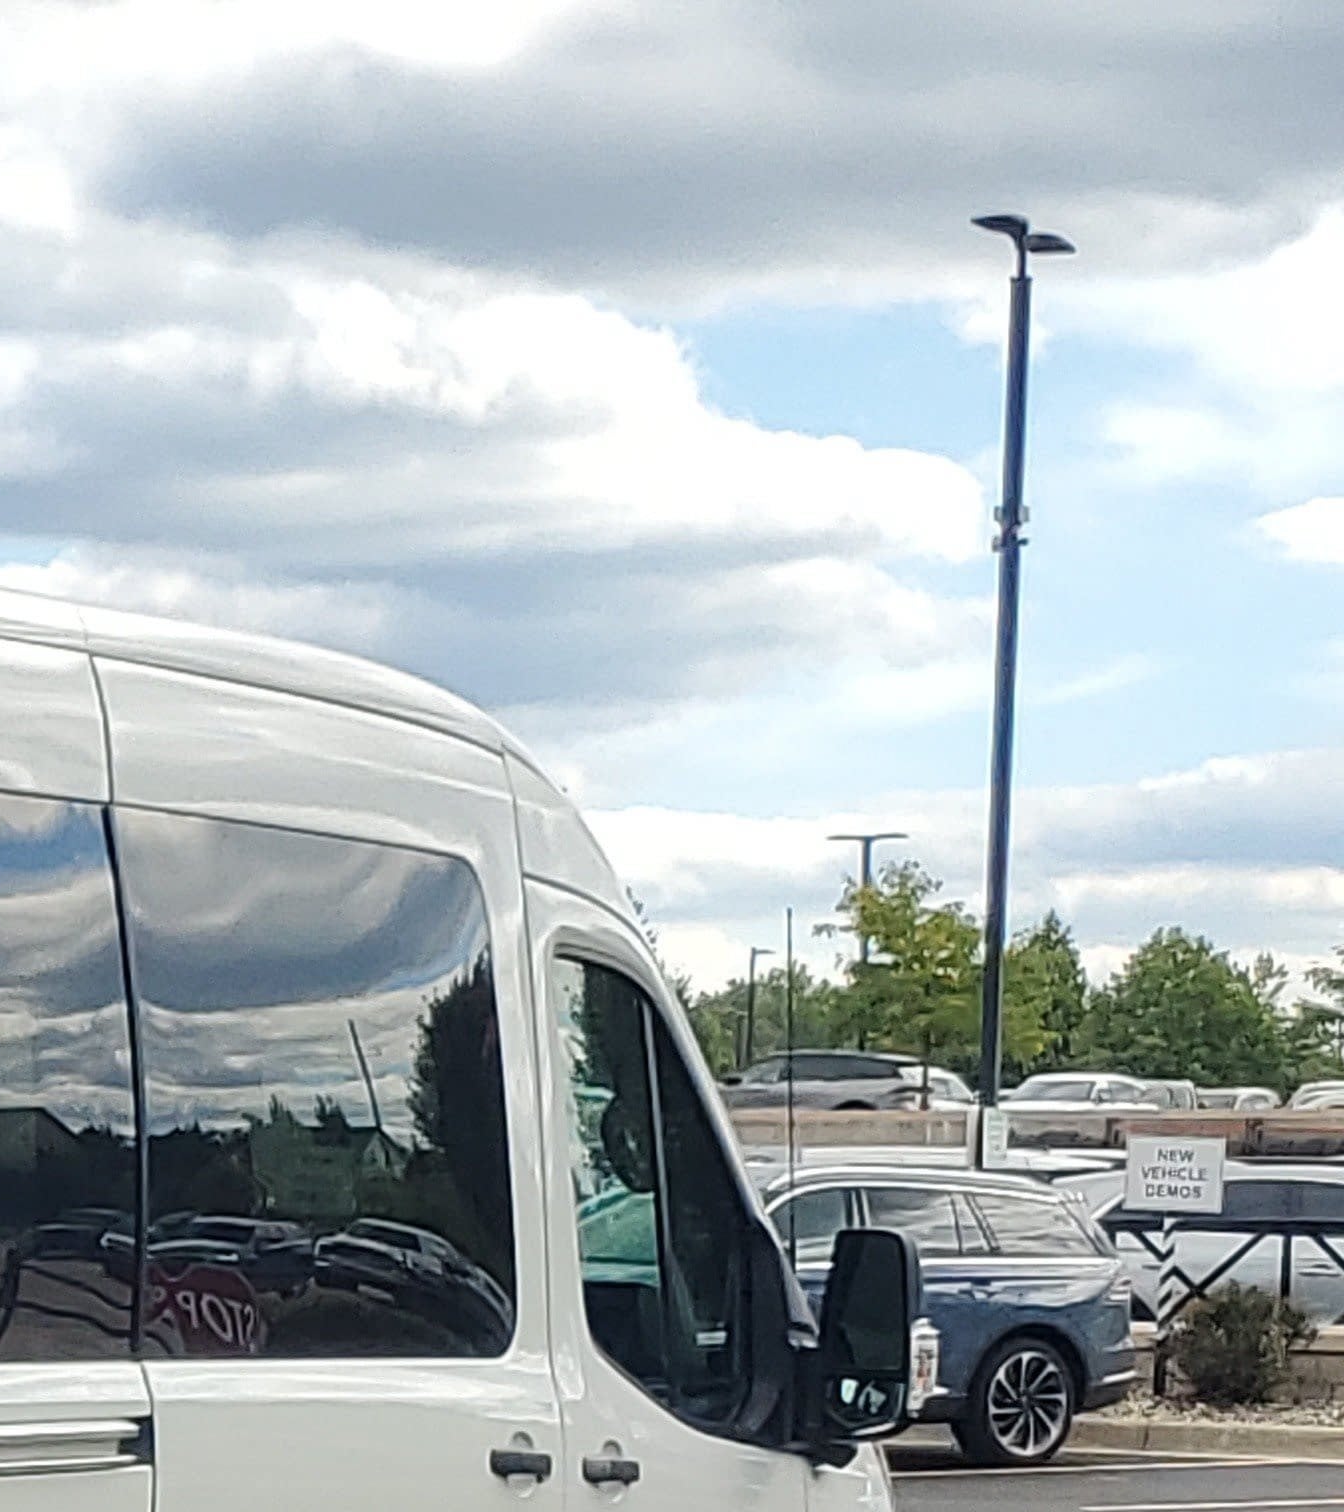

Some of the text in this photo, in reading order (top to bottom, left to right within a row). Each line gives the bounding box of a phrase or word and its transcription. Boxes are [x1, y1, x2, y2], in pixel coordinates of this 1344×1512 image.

[1157, 1148, 1194, 1162] NEW
[1141, 1166, 1209, 1181] VEHICLE
[1145, 1183, 1202, 1199] DEMOS
